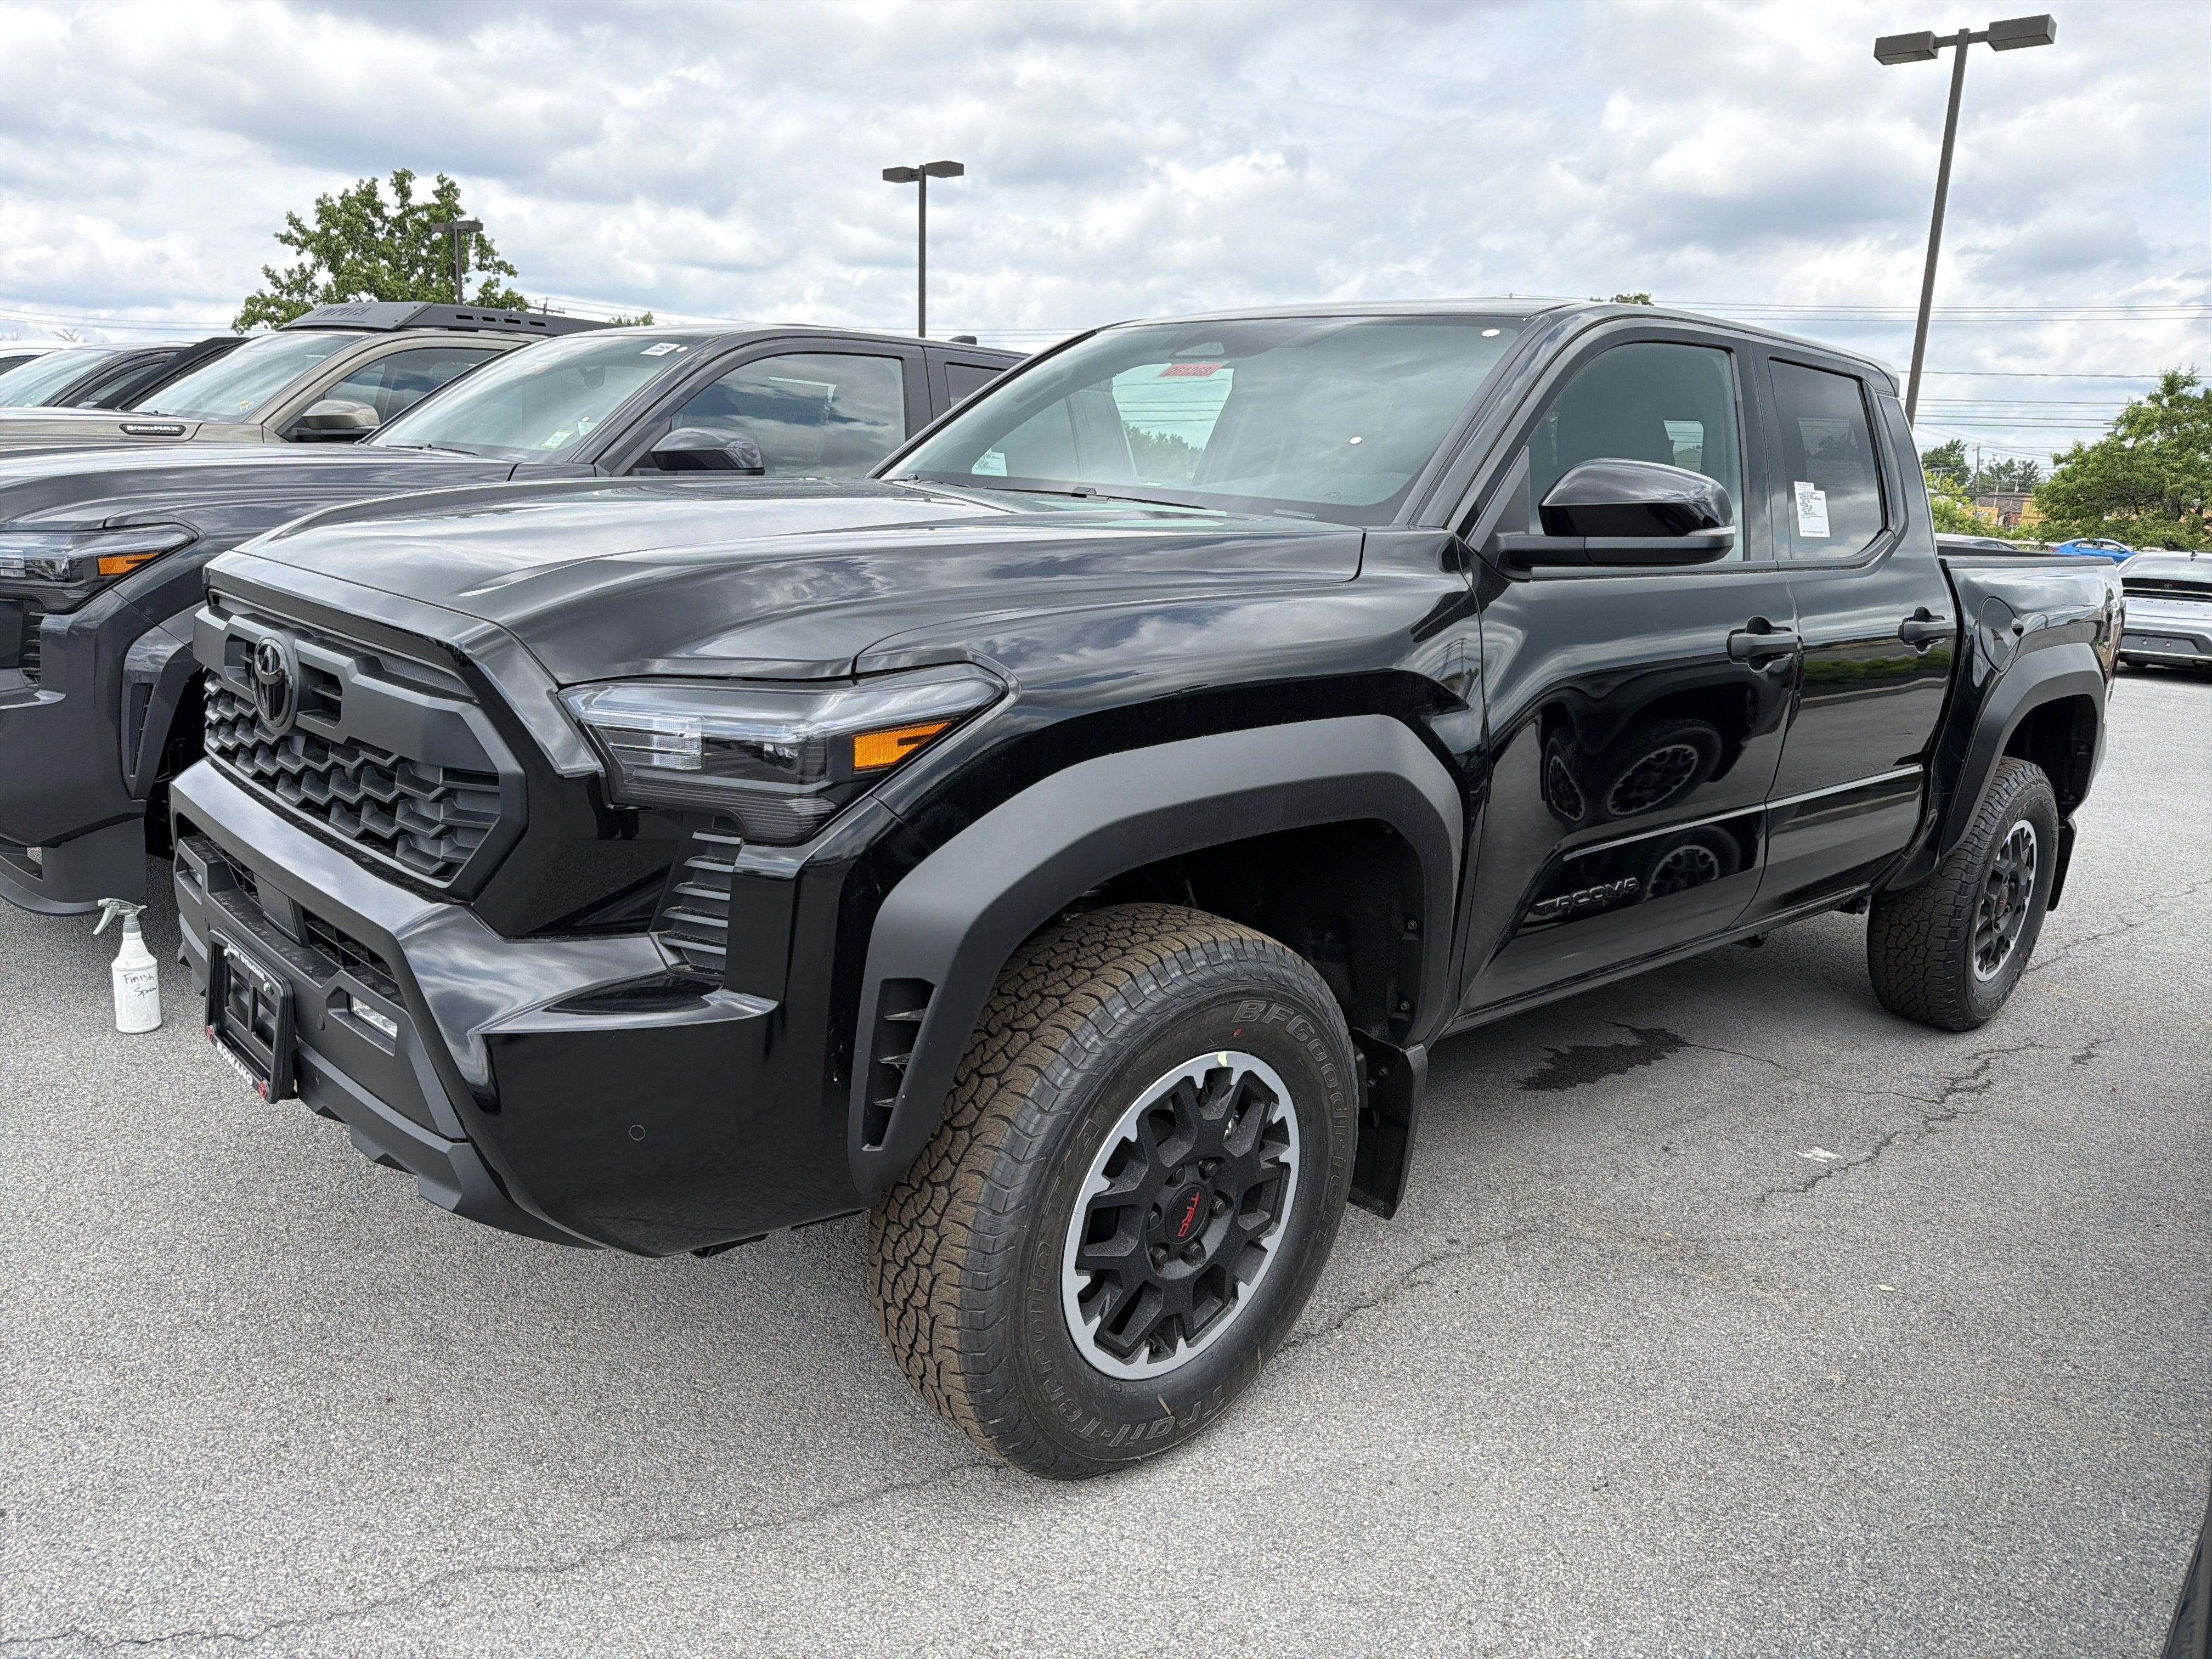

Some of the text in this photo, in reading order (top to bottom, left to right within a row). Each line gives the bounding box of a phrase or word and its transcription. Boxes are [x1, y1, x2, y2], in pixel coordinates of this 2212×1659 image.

[876, 698, 930, 712] ACOMA
[1534, 877, 1640, 916] TACOMA
[217, 1041, 253, 1086] ROMANO
[1231, 1000, 1348, 1246] BFGoodrich
[1177, 1192, 1200, 1238] TRD
